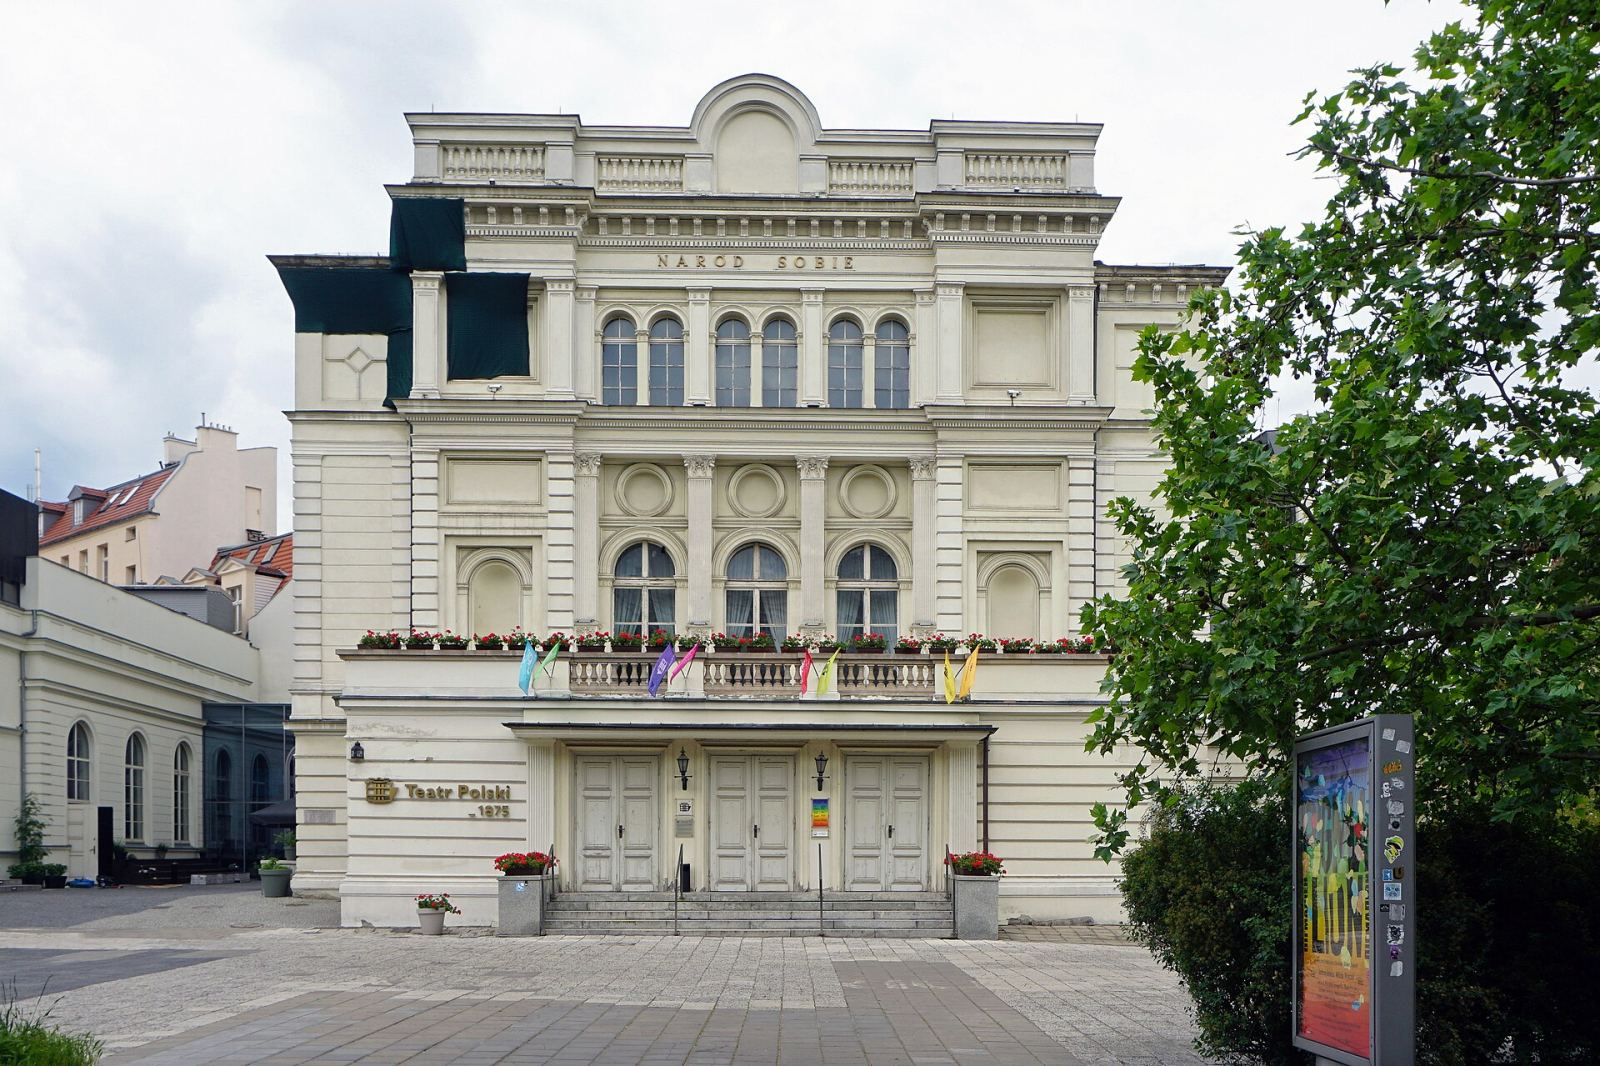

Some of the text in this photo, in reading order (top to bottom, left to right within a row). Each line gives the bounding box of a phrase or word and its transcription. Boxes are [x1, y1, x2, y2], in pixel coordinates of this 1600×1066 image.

[778, 256, 853, 269] SOBIE
[405, 784, 511, 800] Teatr Polski
[478, 805, 509, 818] 1875
